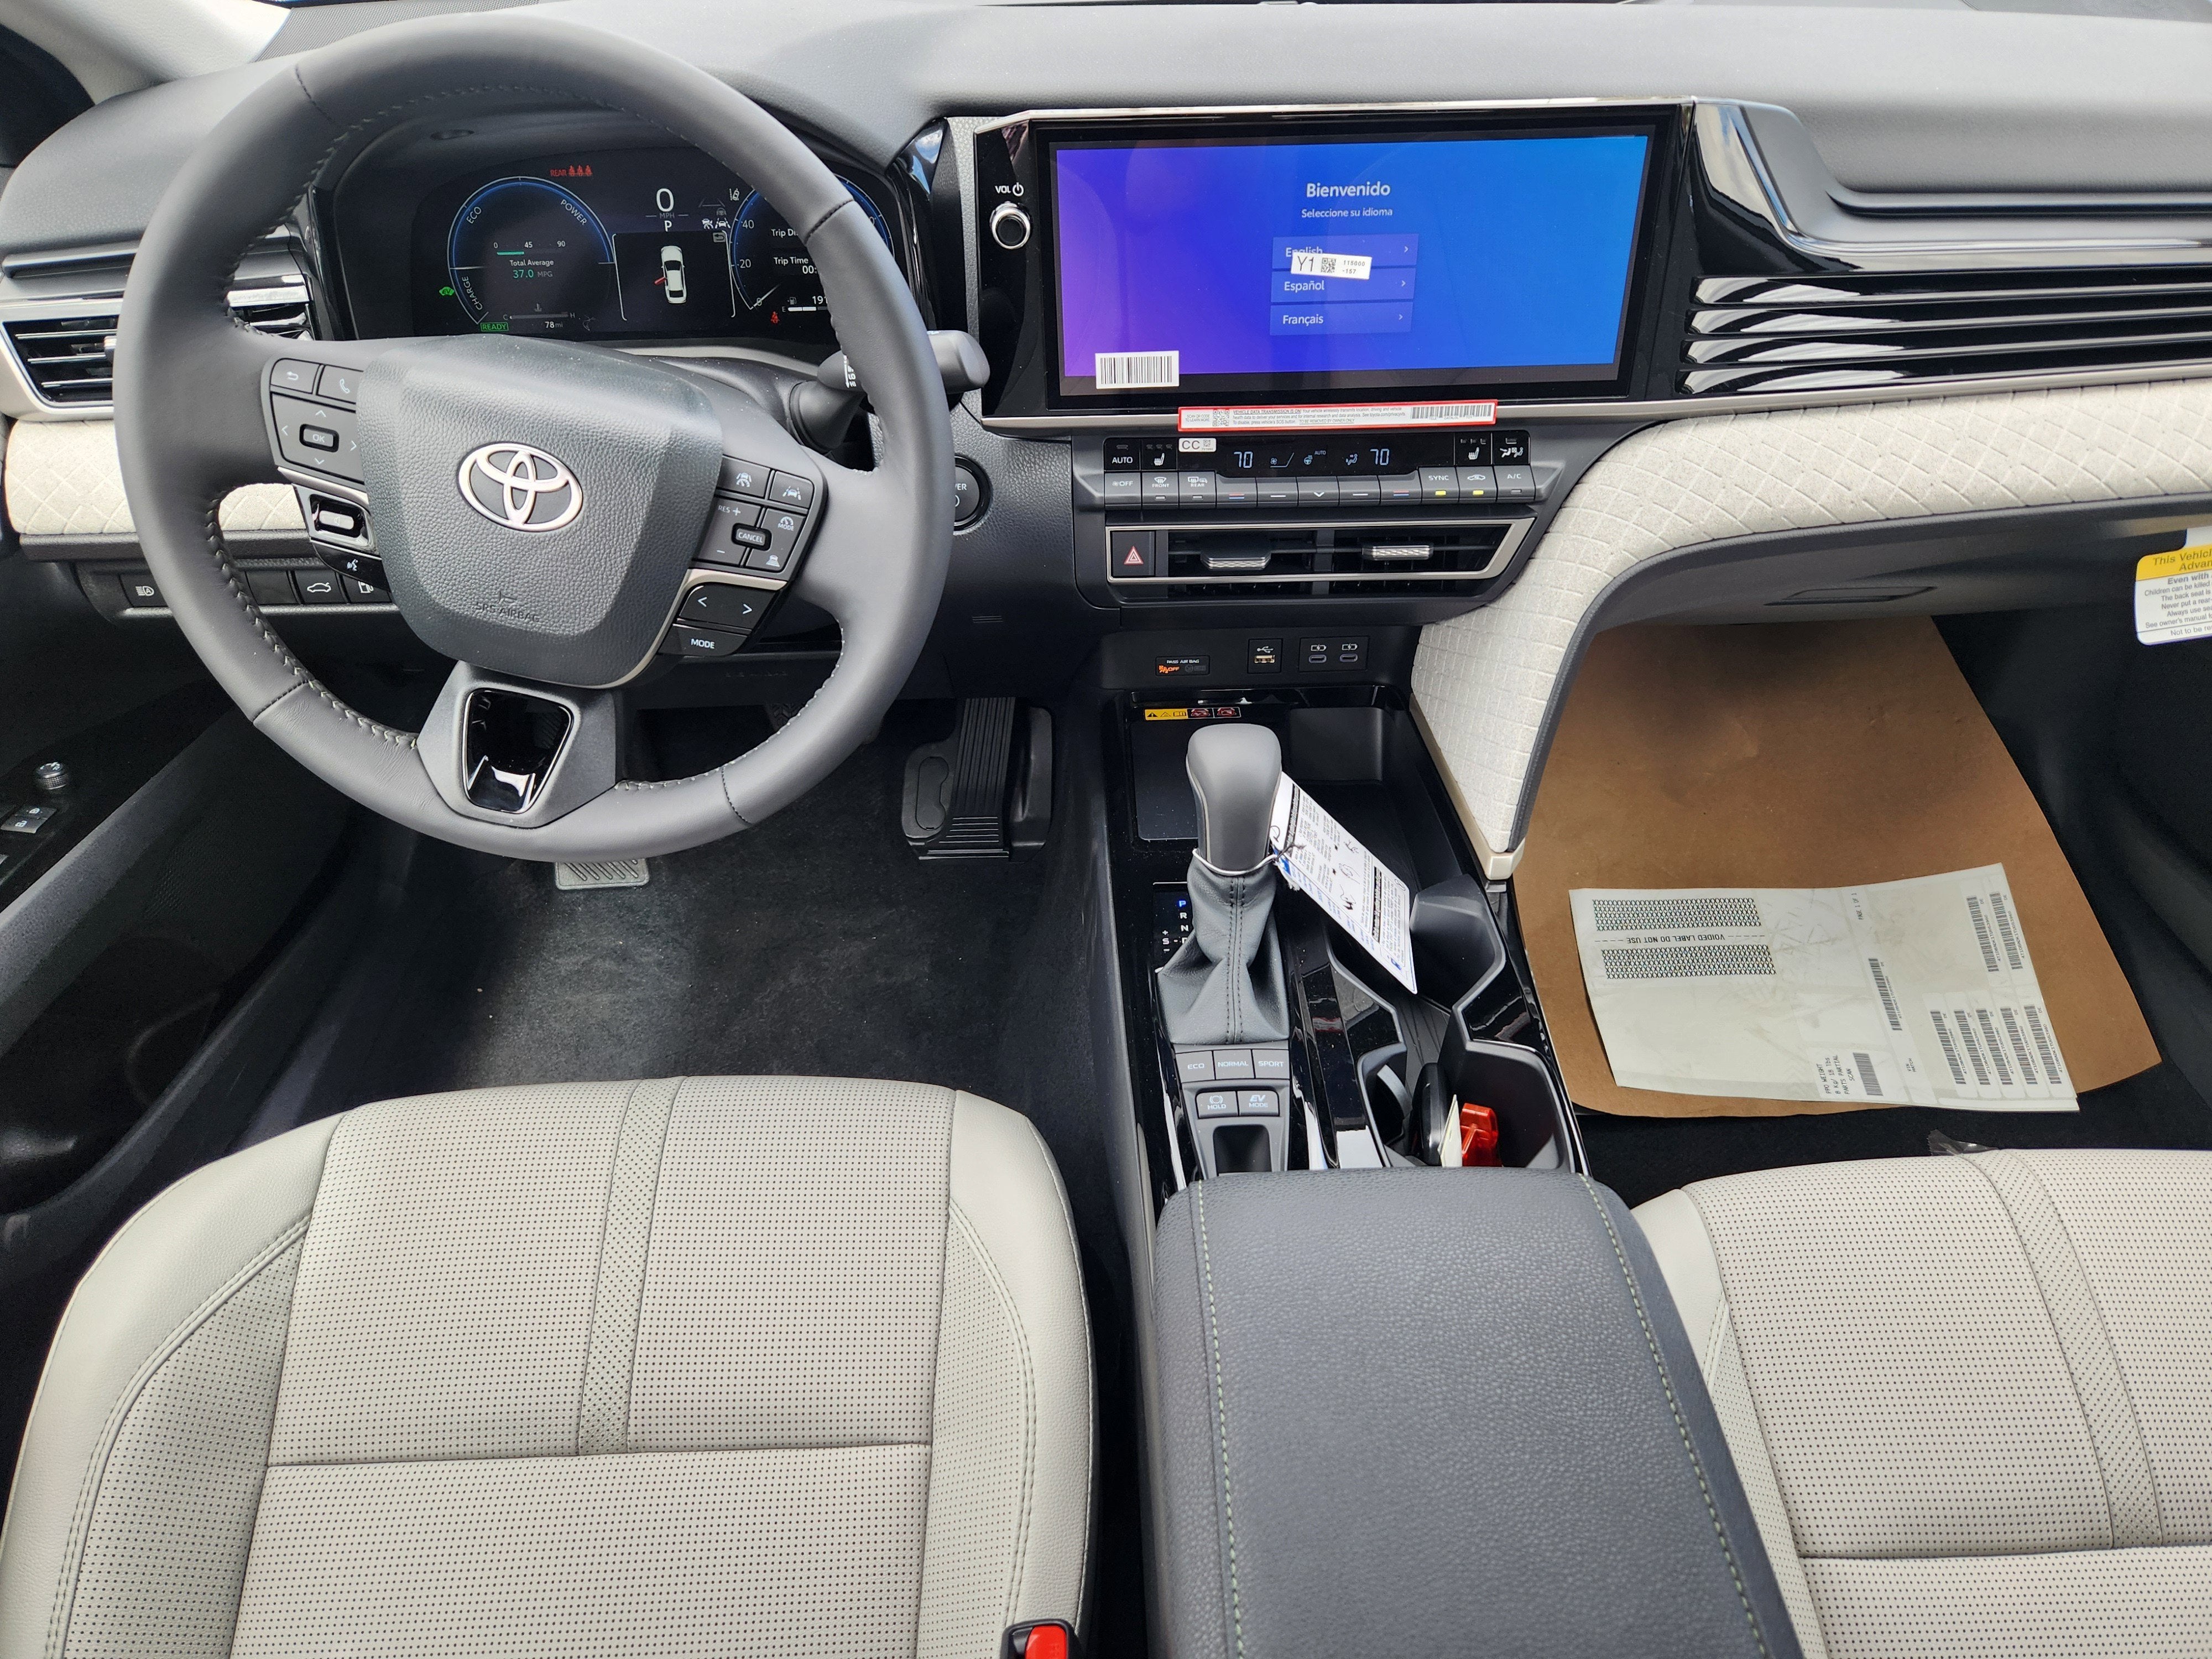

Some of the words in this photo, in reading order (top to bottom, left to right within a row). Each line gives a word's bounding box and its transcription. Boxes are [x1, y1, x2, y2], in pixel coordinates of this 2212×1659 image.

[995, 185, 1011, 194] VOL
[1306, 181, 1391, 198] Bienvenido
[656, 188, 674, 212] 0
[466, 206, 482, 225] ECO
[561, 199, 587, 226] POWER
[1301, 208, 1349, 218] Seleccione
[1363, 207, 1393, 217] idioma
[665, 221, 671, 232] P
[742, 220, 754, 229] 40
[771, 229, 786, 238] Trip
[528, 259, 554, 268] Average
[739, 259, 752, 268] 20
[774, 257, 789, 265] Trip
[1297, 255, 1314, 272] Y1
[513, 269, 534, 278] 37.0
[1284, 280, 1325, 293] Español
[461, 276, 483, 310] CHARGE
[1282, 314, 1323, 326] Français
[313, 434, 325, 442] OK
[1182, 440, 1200, 450] CC
[1233, 451, 1253, 468] 70
[1370, 448, 1390, 465] 70
[718, 504, 730, 513] RES
[778, 523, 795, 531] MODE
[738, 532, 763, 544] CANCEL
[2153, 556, 2176, 566] This
[2168, 576, 2188, 585] Even
[2192, 572, 2209, 581] with
[2145, 588, 2170, 596] Children
[499, 608, 540, 623] AIRBAG
[2167, 609, 2188, 617] Always
[2159, 618, 2182, 626] owner's
[2184, 614, 2207, 622] manual
[691, 638, 715, 649] MODE
[1833, 1055, 1844, 1076] PARTIAL
[1817, 1063, 1827, 1082] WEIGHT
[1845, 1068, 1855, 1082] SCAN
[1840, 1079, 1851, 1095] PARTS
